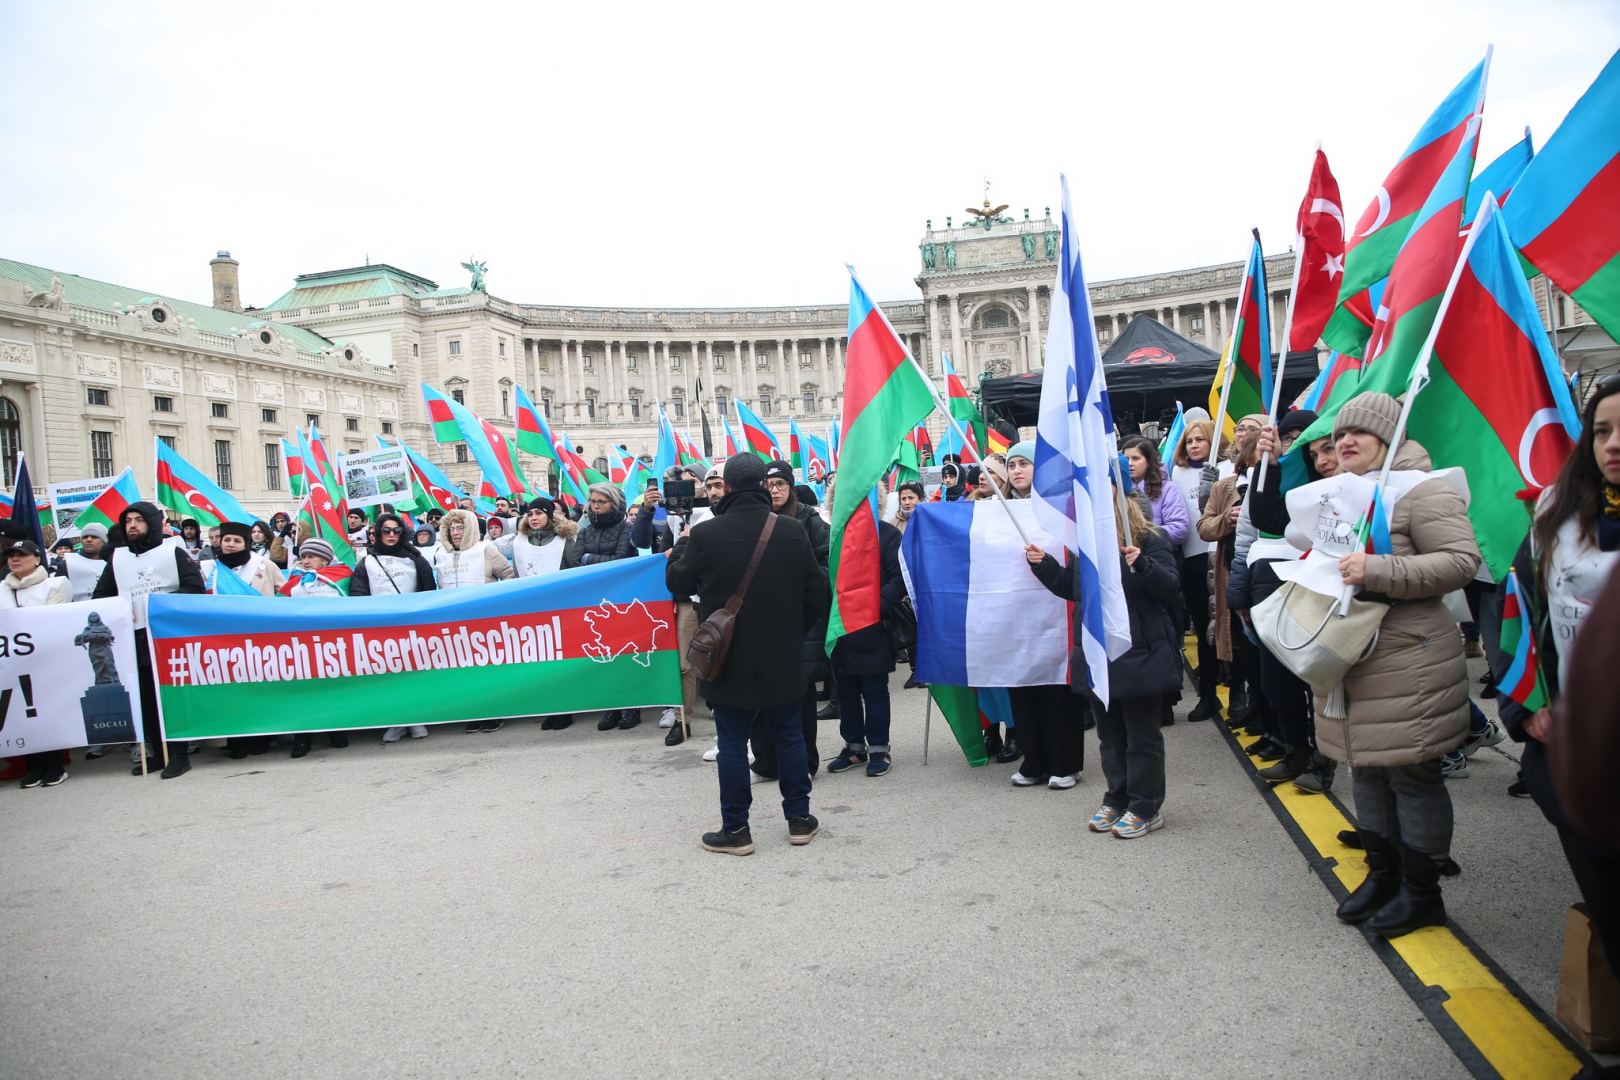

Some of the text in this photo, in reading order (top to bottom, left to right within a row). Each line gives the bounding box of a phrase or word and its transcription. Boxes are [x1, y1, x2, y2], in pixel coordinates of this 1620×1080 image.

[346, 457, 371, 466] Azerbaijan
[56, 487, 86, 495] Monuments
[167, 616, 563, 687] #Karabach ist Aserbaidschan!
